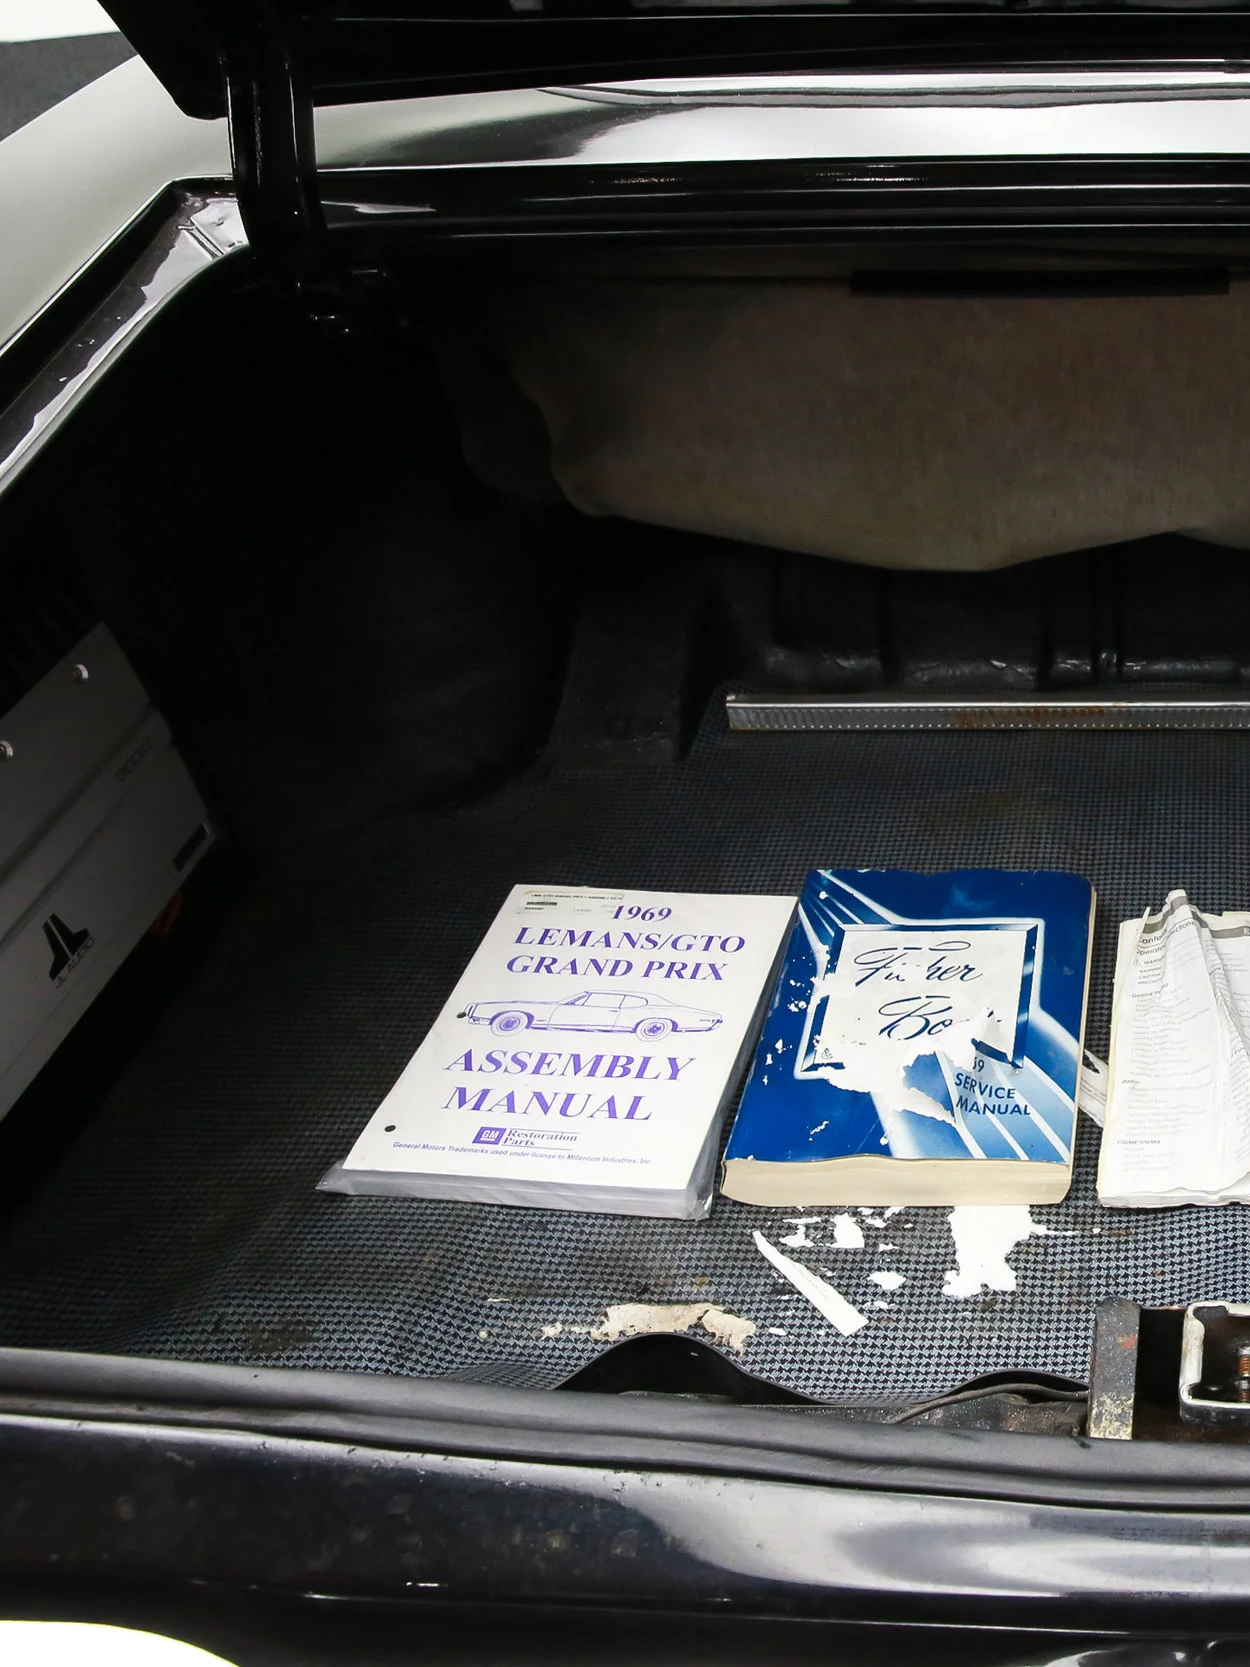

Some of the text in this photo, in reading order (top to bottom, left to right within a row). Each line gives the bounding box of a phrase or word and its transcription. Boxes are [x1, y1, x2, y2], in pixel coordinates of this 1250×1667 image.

[612, 905, 673, 922] 1969
[512, 927, 746, 953] LEMANS/GTO
[506, 955, 729, 981] GRAND PRIX
[442, 1048, 697, 1081] ASSEMBLY
[954, 1072, 1016, 1100] SERVICE
[440, 1085, 653, 1121] MANUAL
[956, 1095, 1031, 1116] MANUAL
[503, 1137, 536, 1146] Parts
[507, 1129, 578, 1142] Restoration
[392, 1141, 421, 1150] General
[421, 1143, 446, 1151] Motors
[447, 1145, 488, 1154] Trademarks
[489, 1148, 508, 1156] used
[530, 1152, 557, 1160] license
